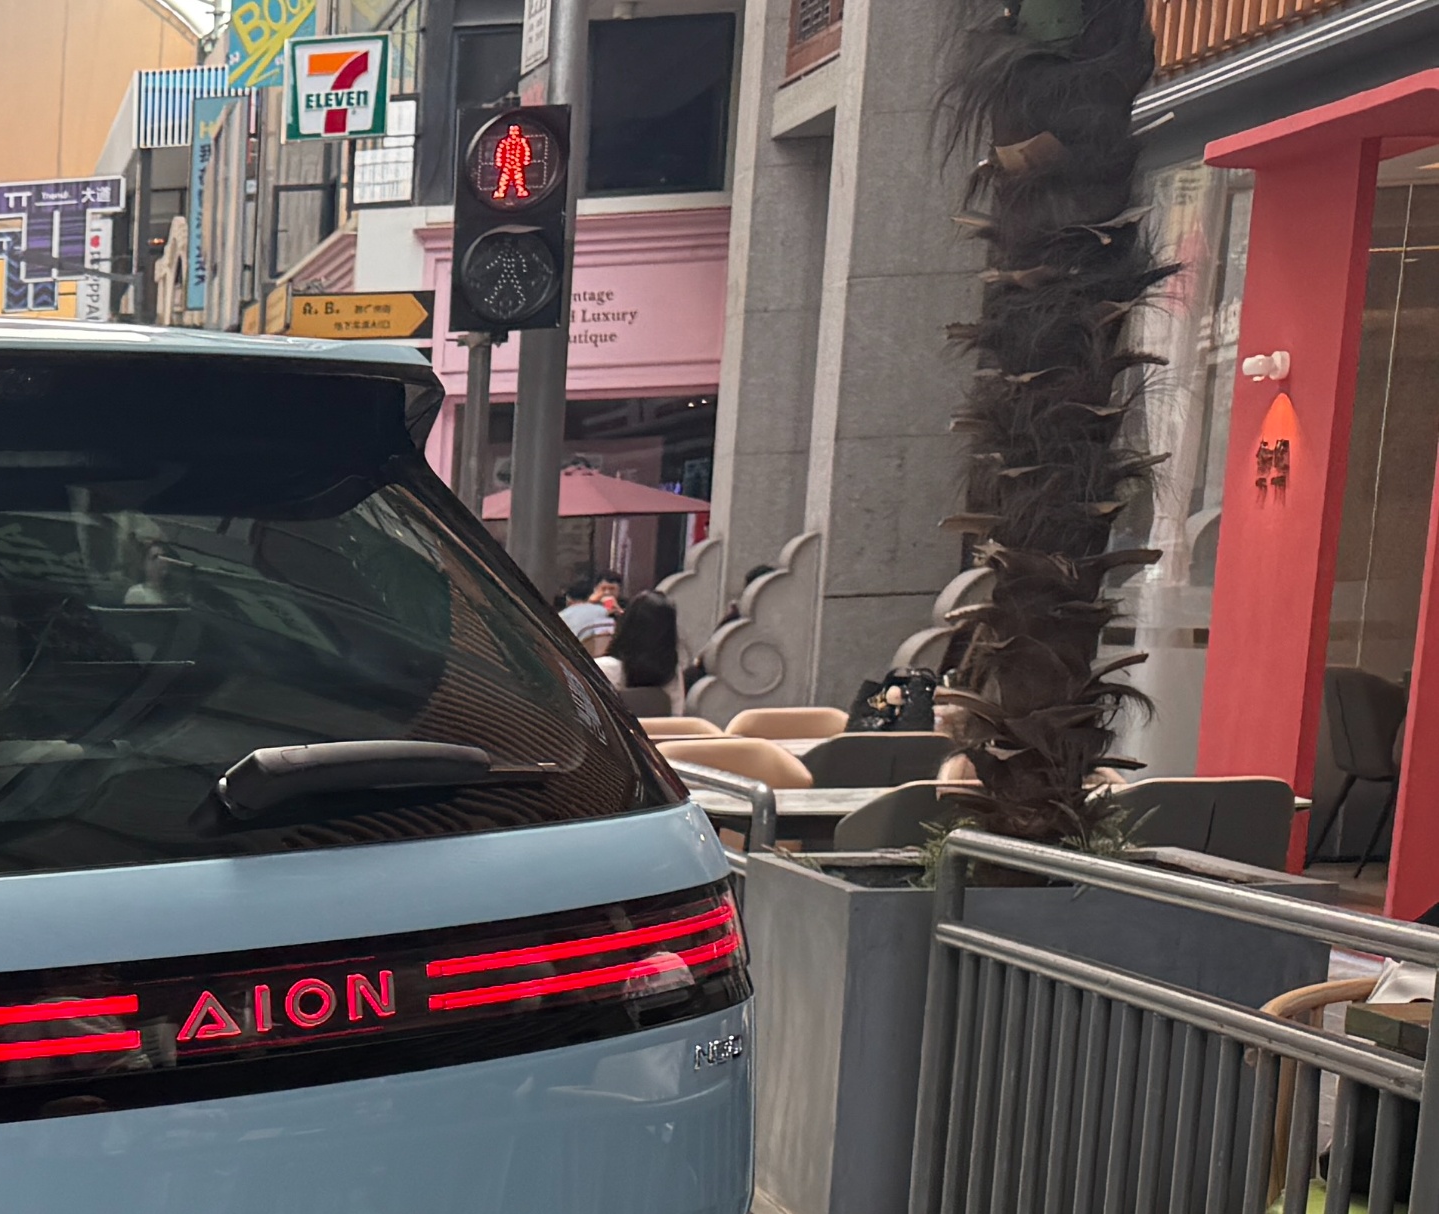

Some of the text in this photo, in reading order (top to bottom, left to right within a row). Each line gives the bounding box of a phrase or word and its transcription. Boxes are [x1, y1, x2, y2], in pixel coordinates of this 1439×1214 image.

[570, 290, 614, 306] ntage
[581, 309, 638, 325] Luxury
[568, 330, 617, 347] utique
[176, 970, 396, 1042] AION
